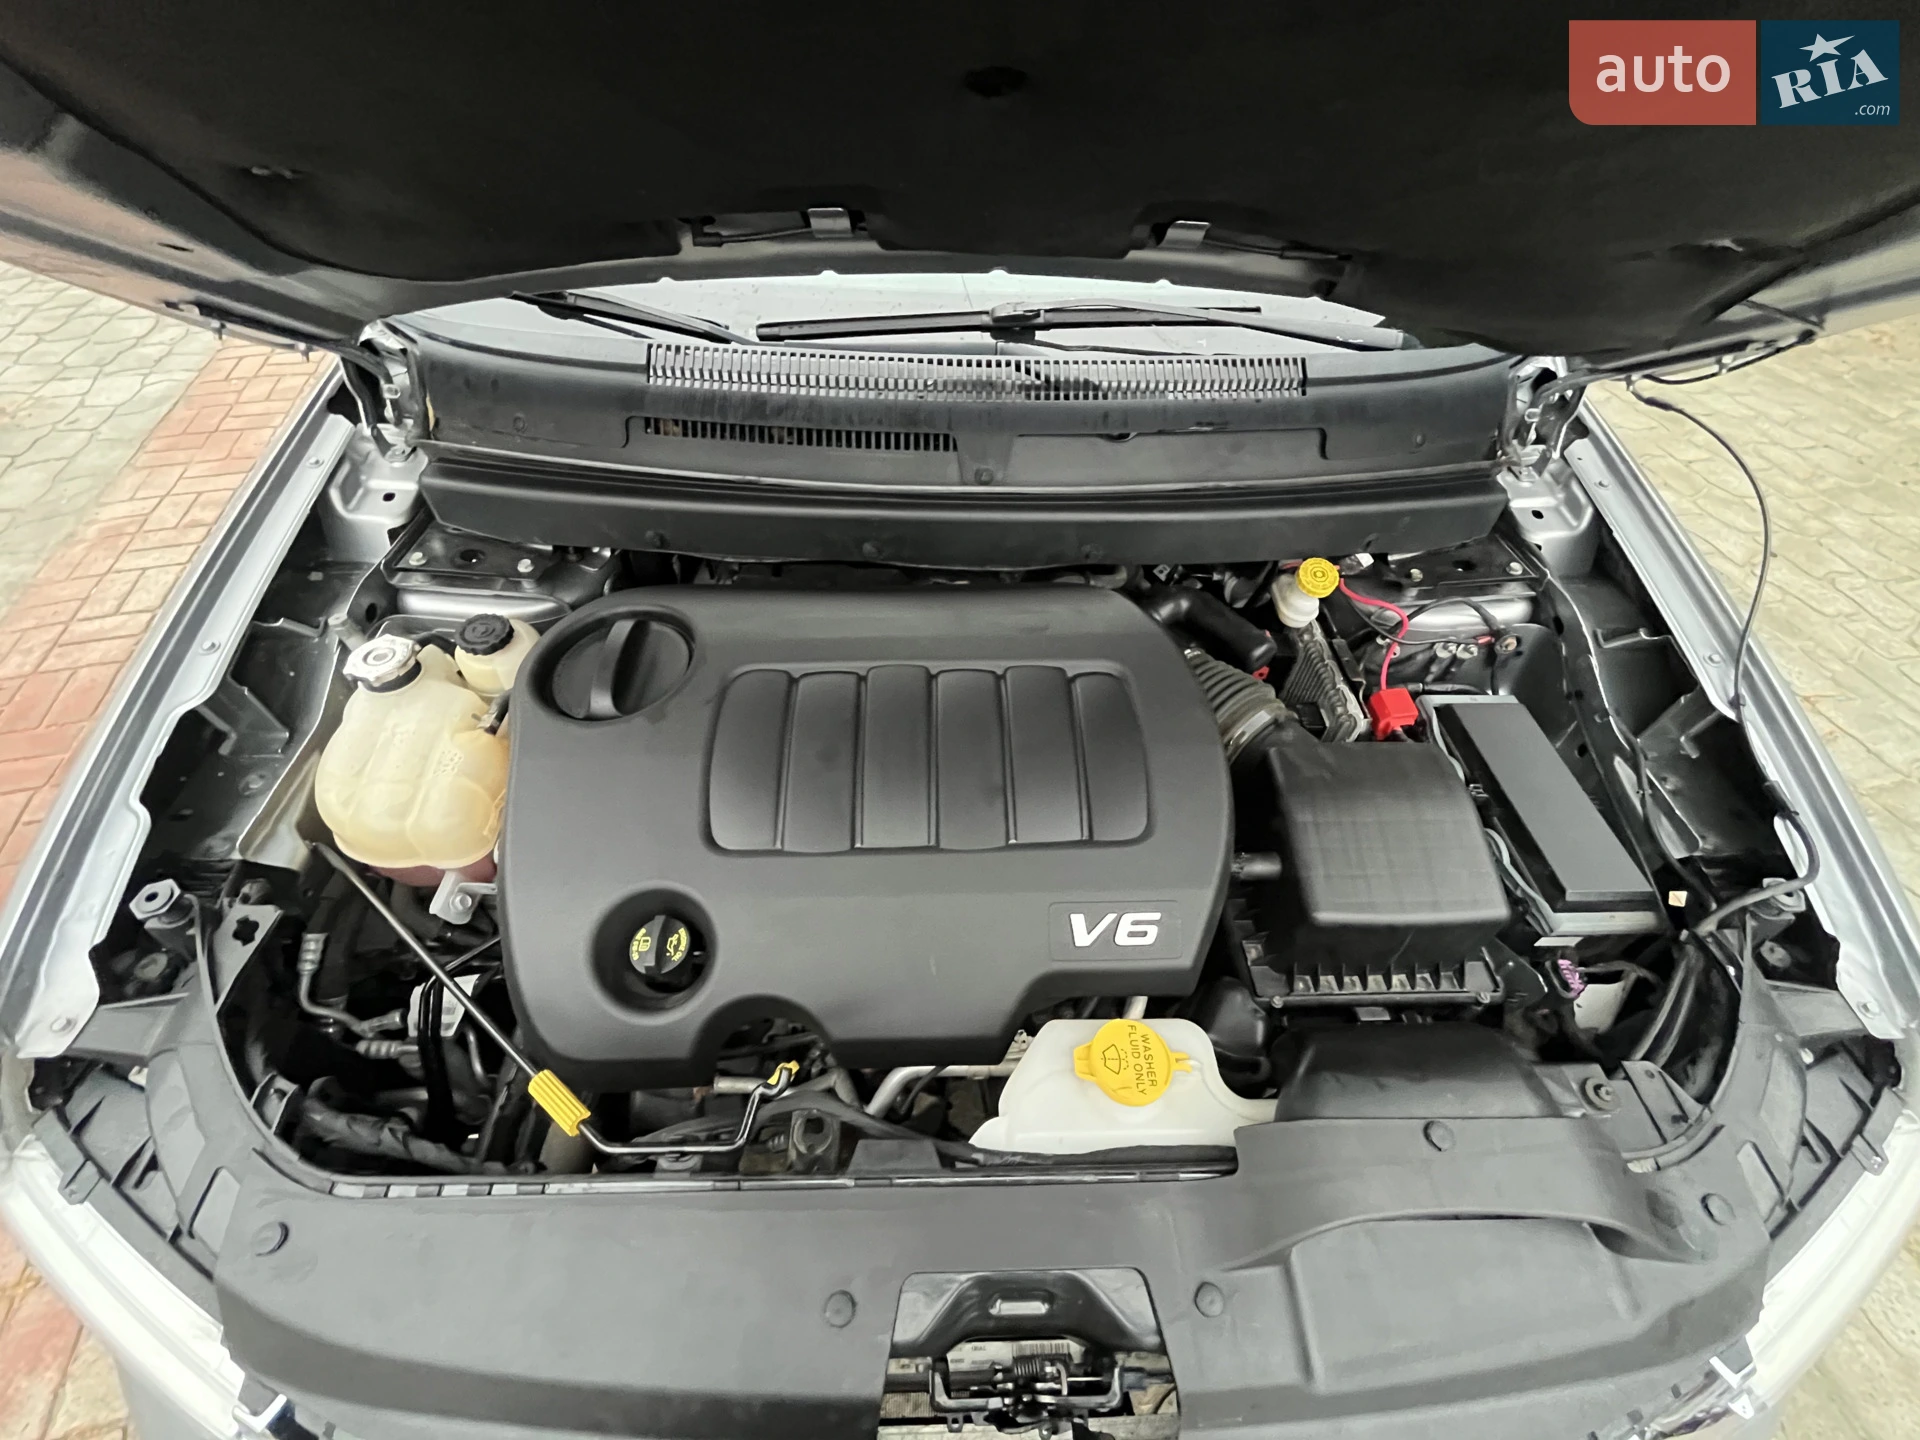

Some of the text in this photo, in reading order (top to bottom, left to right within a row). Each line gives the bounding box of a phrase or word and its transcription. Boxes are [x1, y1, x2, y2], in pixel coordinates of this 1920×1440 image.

[1069, 912, 1162, 947] V6
[1127, 1024, 1147, 1095] FLUID ONLY
[1140, 1033, 1158, 1087] WASHER
